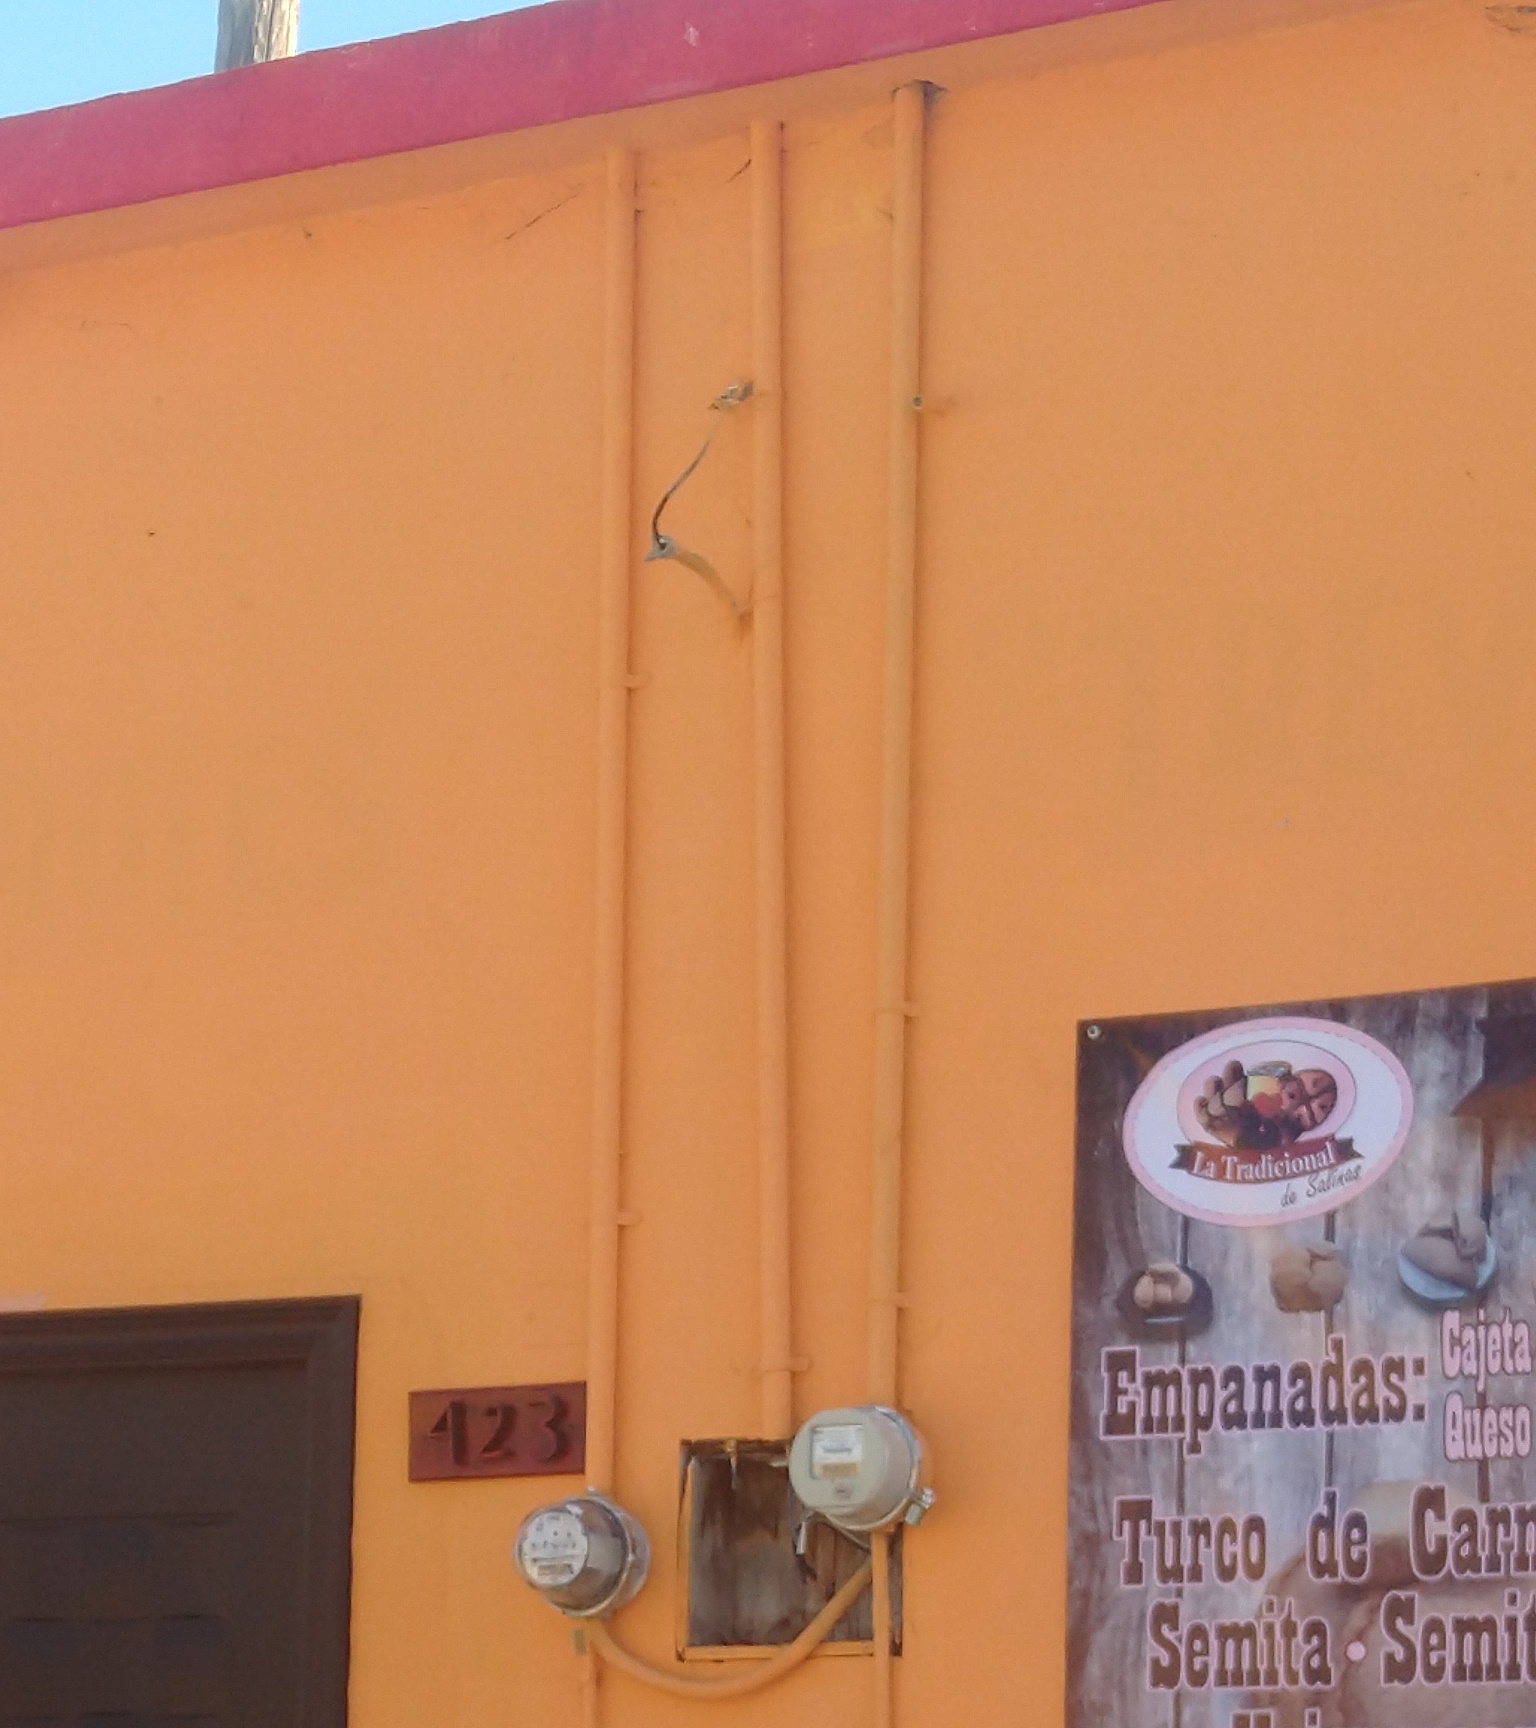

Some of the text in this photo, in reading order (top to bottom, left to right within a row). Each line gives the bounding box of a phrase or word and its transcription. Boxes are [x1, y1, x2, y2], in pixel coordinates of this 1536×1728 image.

[1192, 1141, 1336, 1180] La Tradicional
[1280, 1183, 1297, 1207] de
[1441, 1306, 1532, 1393] Cajeta
[423, 1394, 572, 1466] 423
[1099, 1332, 1428, 1457] Empanadas:
[1444, 1392, 1531, 1461] Queso
[1113, 1495, 1267, 1588] Turco
[1307, 1486, 1371, 1582] de
[1147, 1596, 1333, 1690] Semita
